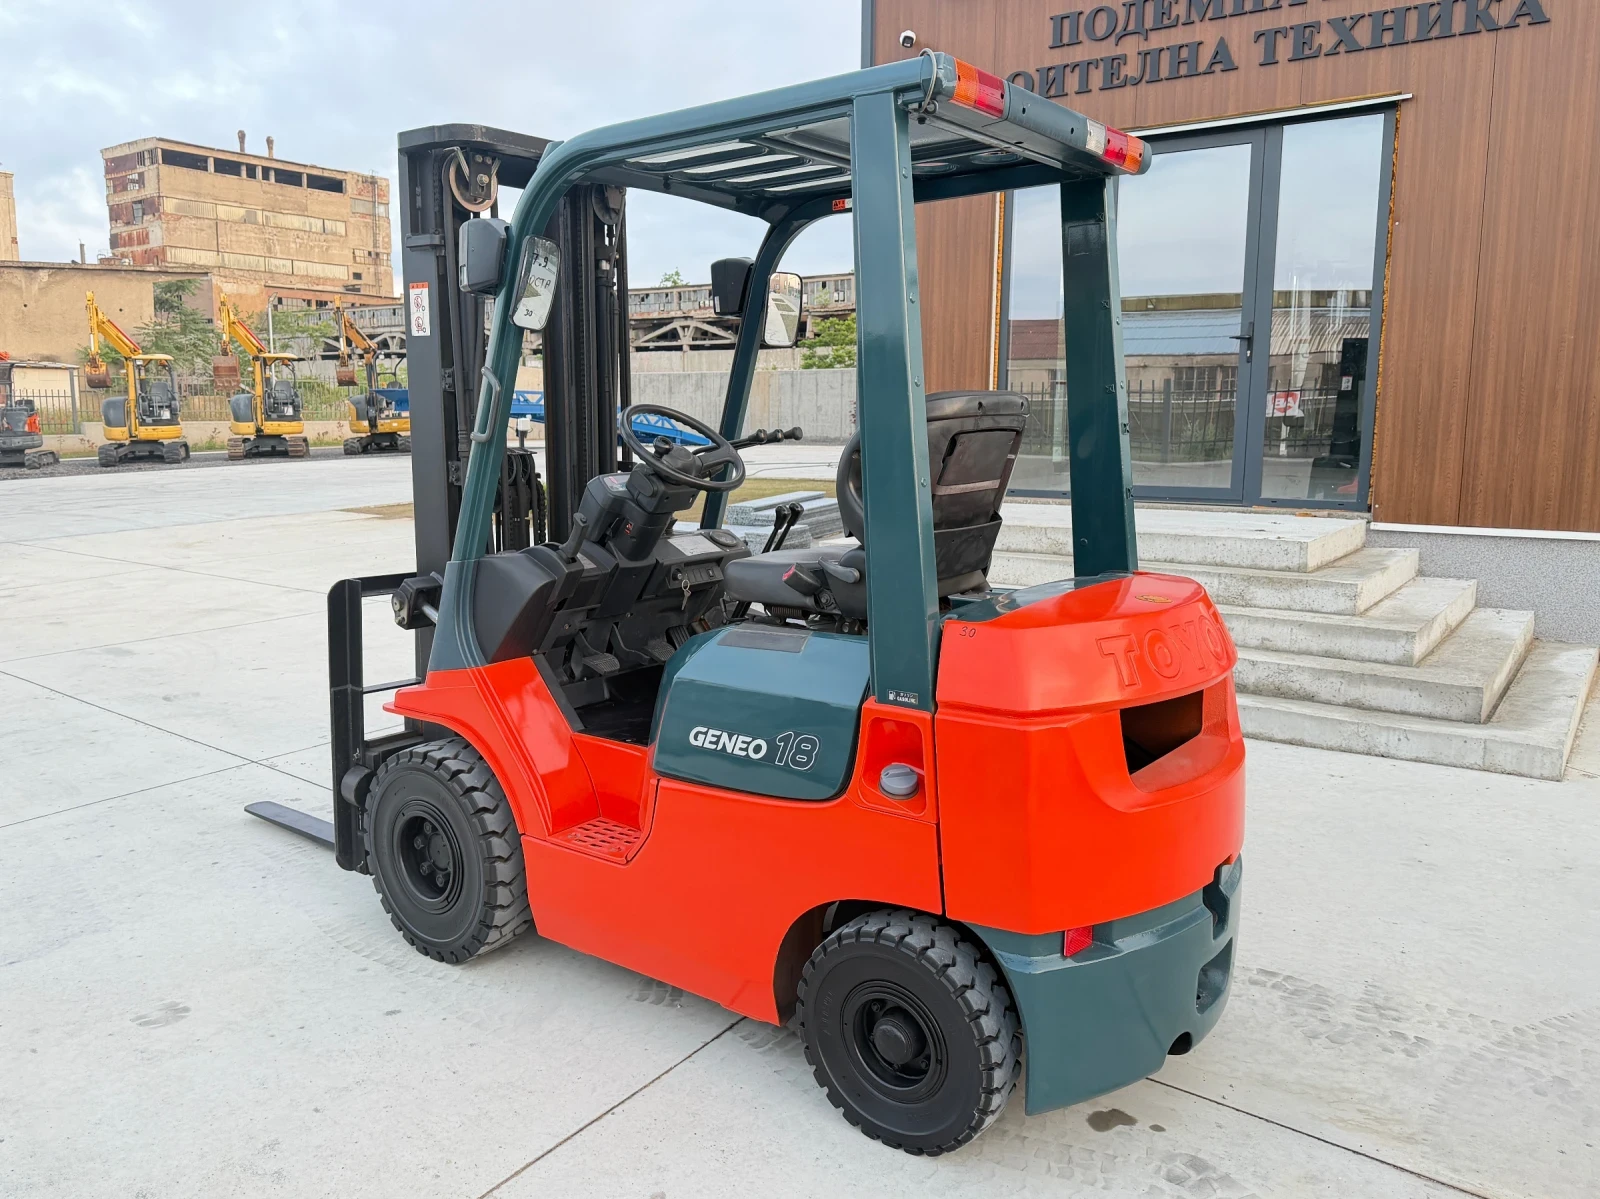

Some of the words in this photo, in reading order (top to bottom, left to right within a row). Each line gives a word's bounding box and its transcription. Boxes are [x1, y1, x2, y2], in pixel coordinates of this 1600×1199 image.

[1048, 0, 1307, 49] ПОДЕМ
[1253, 0, 1550, 66] ТЕХНИКА
[959, 625, 977, 638] 30
[688, 726, 768, 760] GENEO
[775, 731, 820, 771] 18
